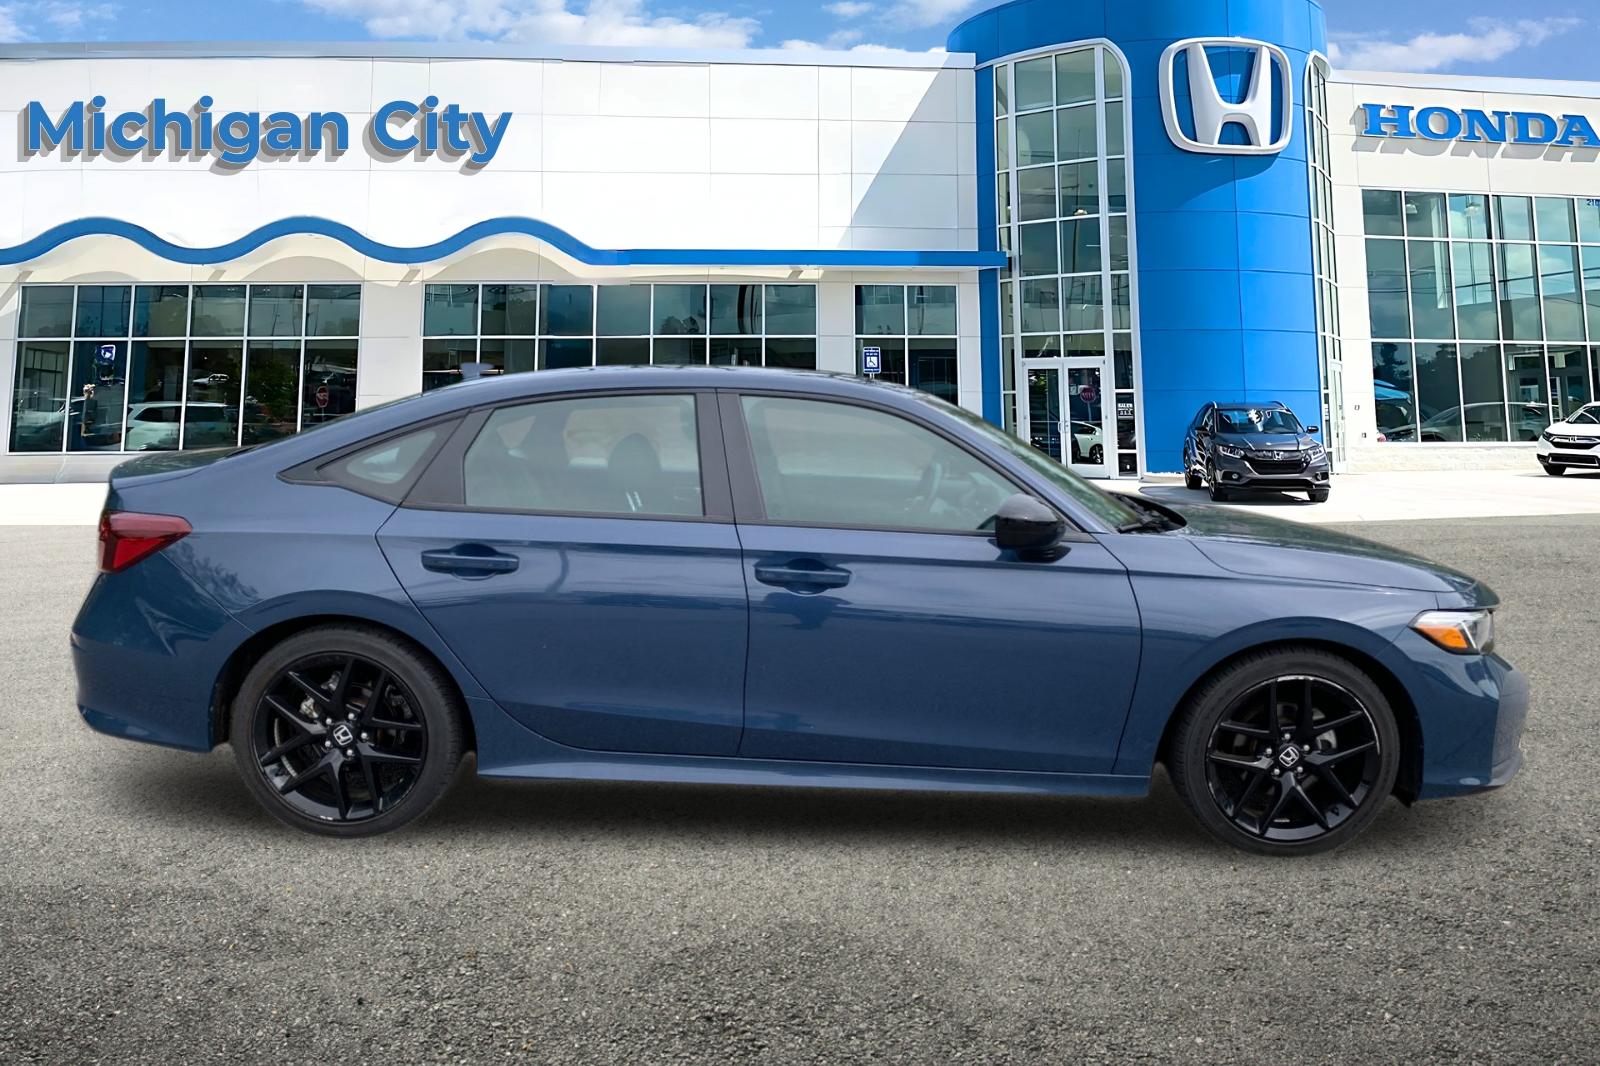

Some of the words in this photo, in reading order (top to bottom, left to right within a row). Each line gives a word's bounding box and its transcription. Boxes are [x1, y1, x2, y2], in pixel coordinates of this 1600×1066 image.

[28, 95, 349, 163] Michigan
[373, 95, 513, 163] City
[1360, 103, 1600, 148] HONDA
